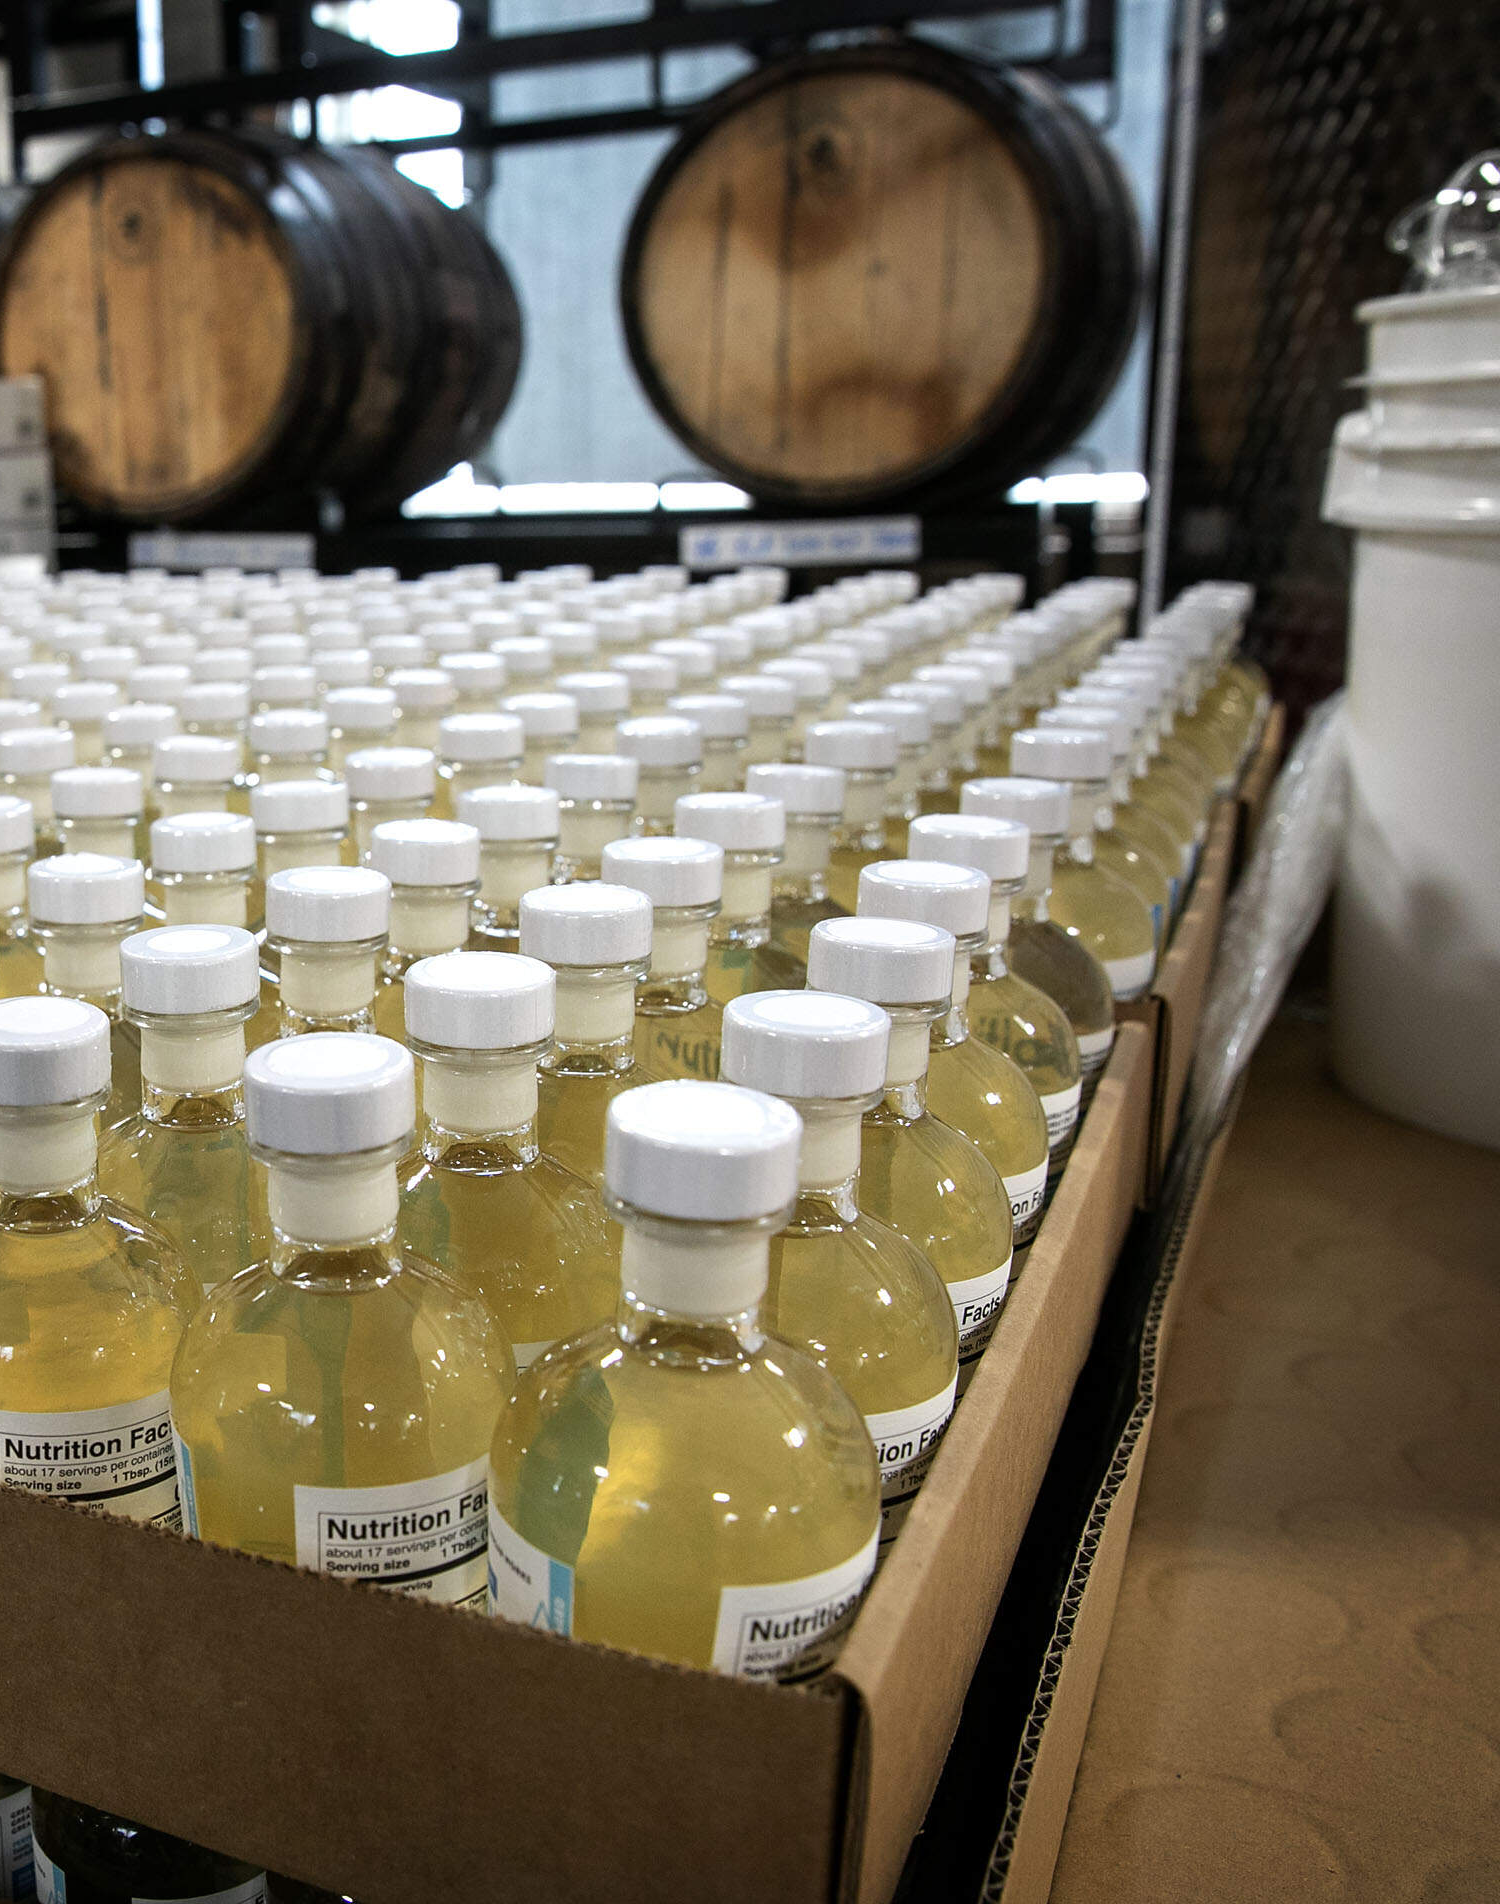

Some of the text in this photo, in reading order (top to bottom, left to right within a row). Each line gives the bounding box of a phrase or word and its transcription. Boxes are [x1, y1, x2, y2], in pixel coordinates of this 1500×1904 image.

[961, 1296, 1001, 1326] Facts
[4, 1436, 122, 1461] Nutrition
[4, 1464, 37, 1478] about
[42, 1468, 55, 1478] 17
[59, 1464, 108, 1479] servings
[110, 1459, 128, 1472] per
[4, 1477, 52, 1491] Serving
[56, 1479, 82, 1490] size
[112, 1474, 118, 1484] 1
[122, 1467, 153, 1481] Tbsp.
[327, 1508, 451, 1540] Nutrition
[325, 1547, 362, 1559] about
[368, 1547, 383, 1557] 17
[386, 1539, 437, 1557] servings
[439, 1531, 457, 1548] per
[326, 1561, 380, 1574] Serving
[384, 1559, 411, 1571] size
[442, 1548, 447, 1558] 1
[451, 1536, 480, 1555] Tbsp.
[750, 1594, 860, 1643] Nutrition
